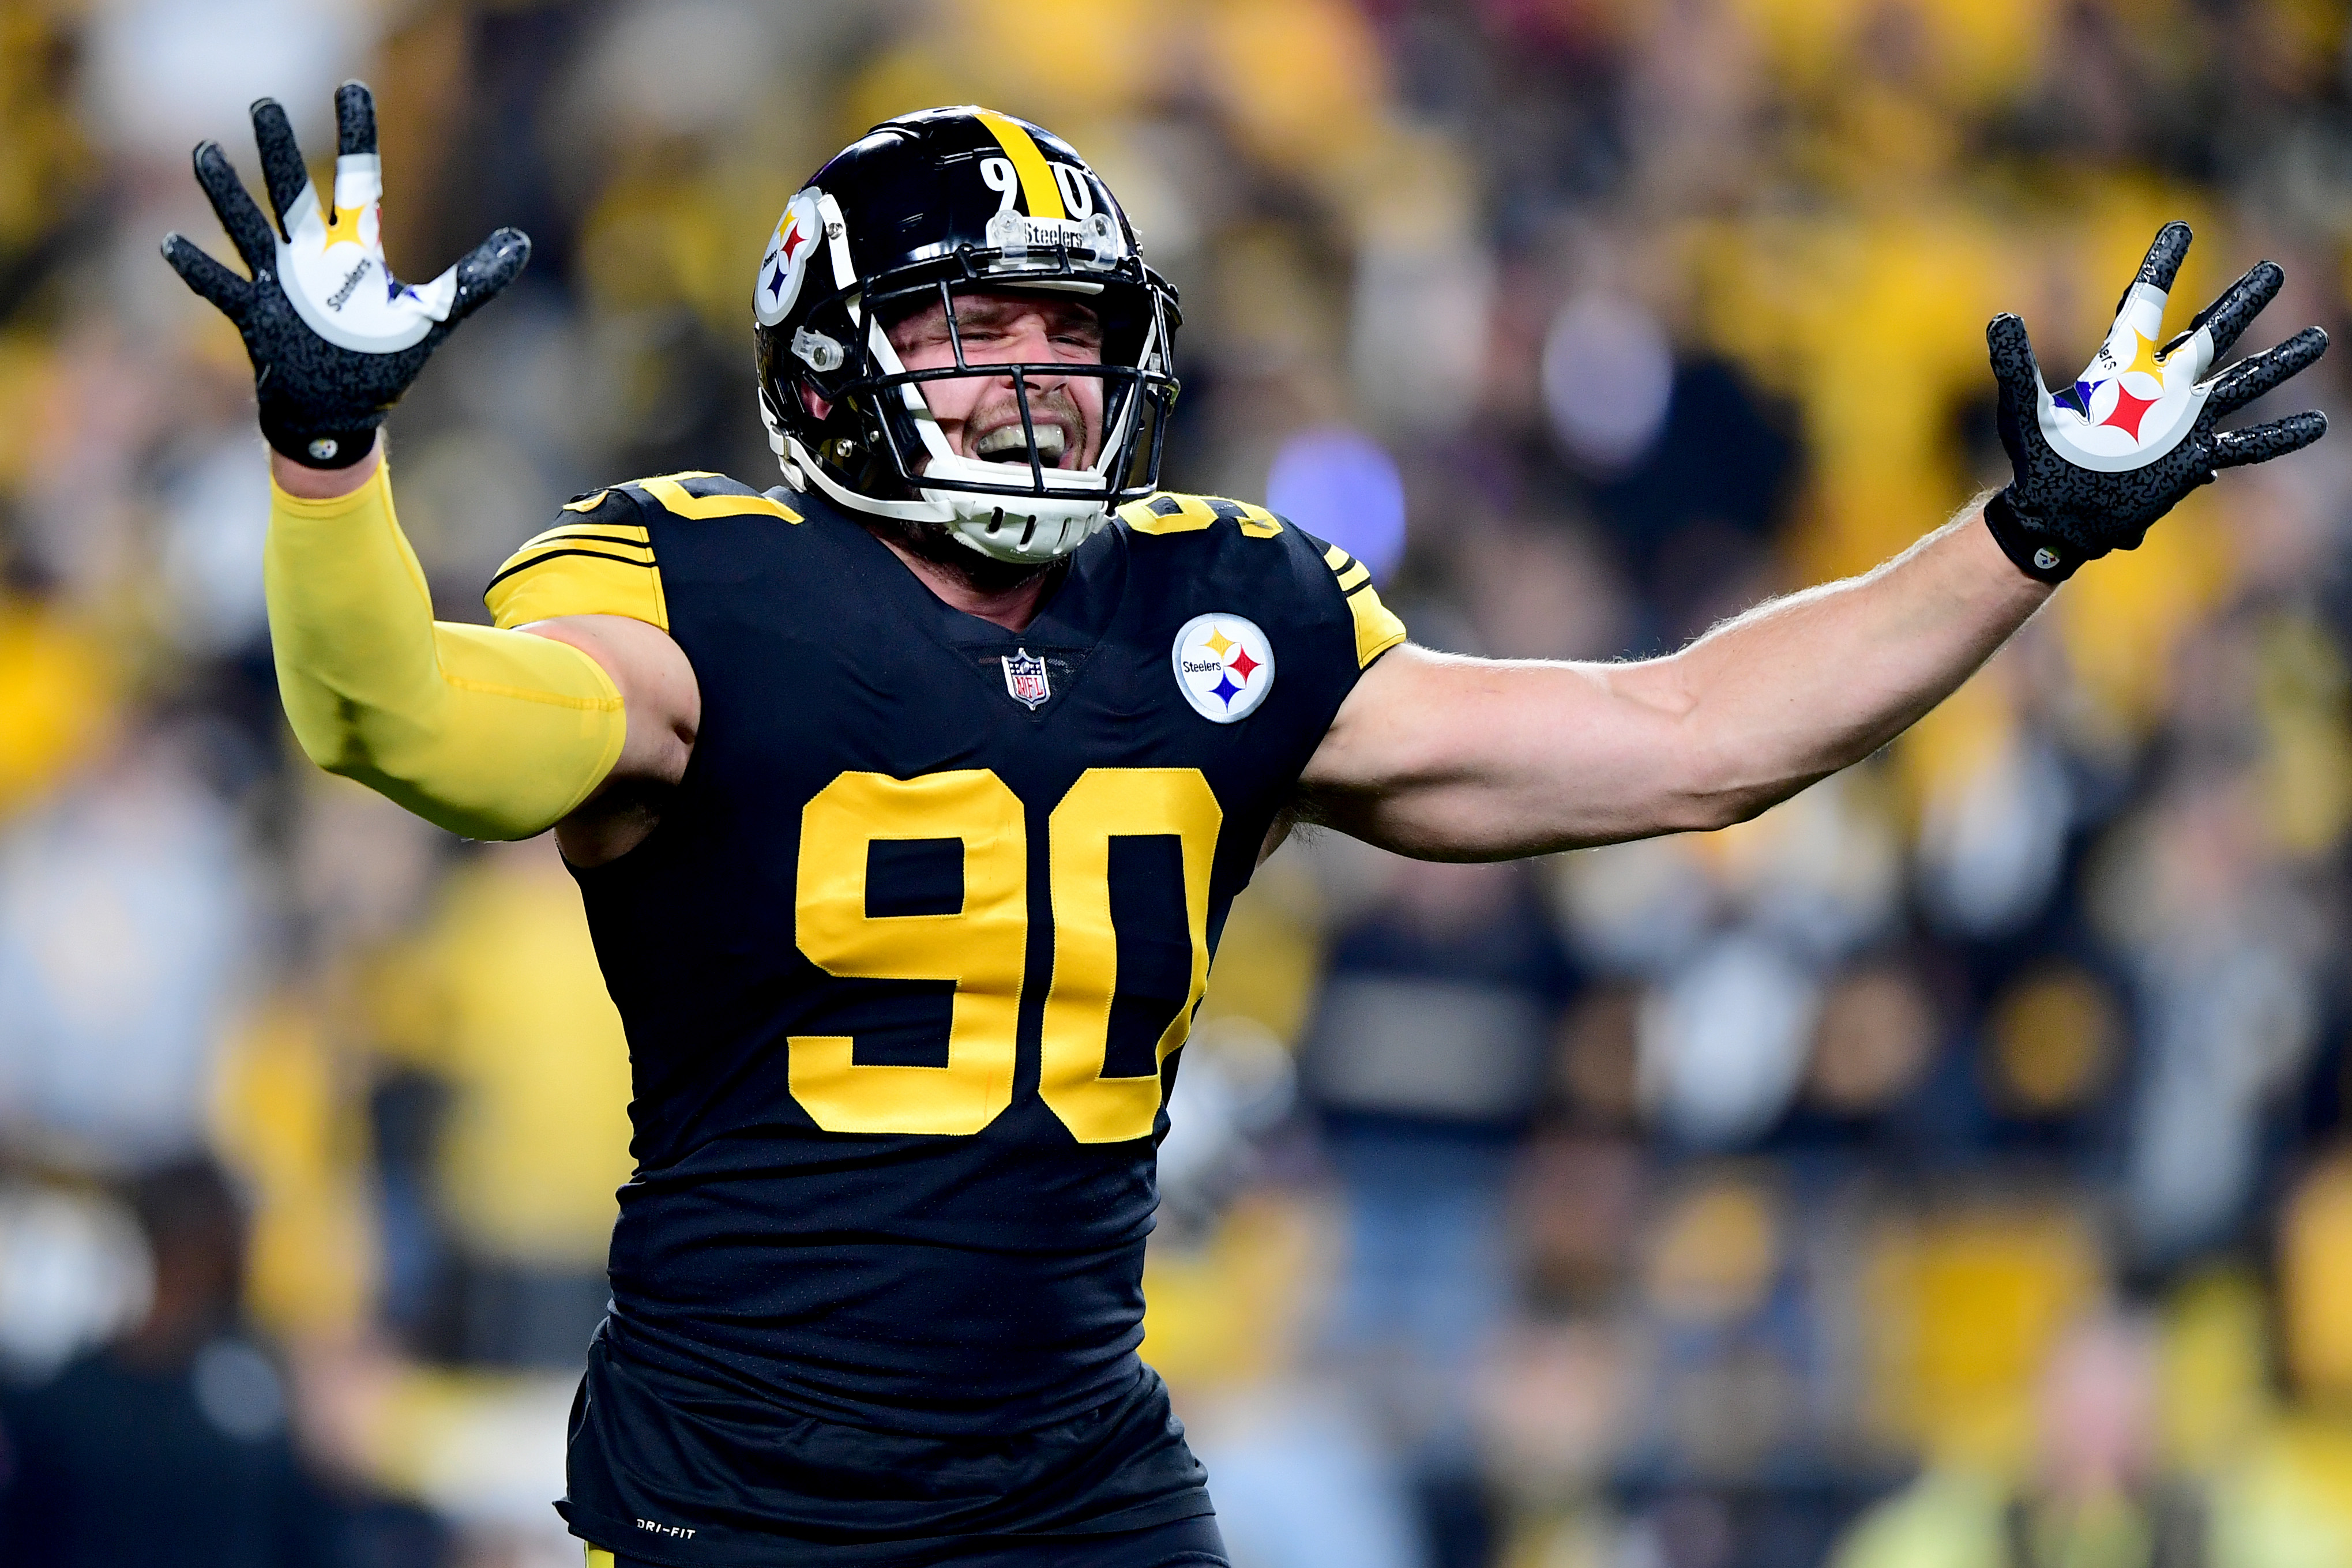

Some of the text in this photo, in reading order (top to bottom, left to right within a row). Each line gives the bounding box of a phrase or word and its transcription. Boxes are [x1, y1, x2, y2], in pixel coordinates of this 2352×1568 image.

[1024, 223, 1083, 248] Steelers
[1183, 660, 1221, 672] Steelers
[1015, 676, 1043, 698] NFL
[787, 768, 1223, 1143] 90
[637, 1518, 696, 1539] DRI-FIT
